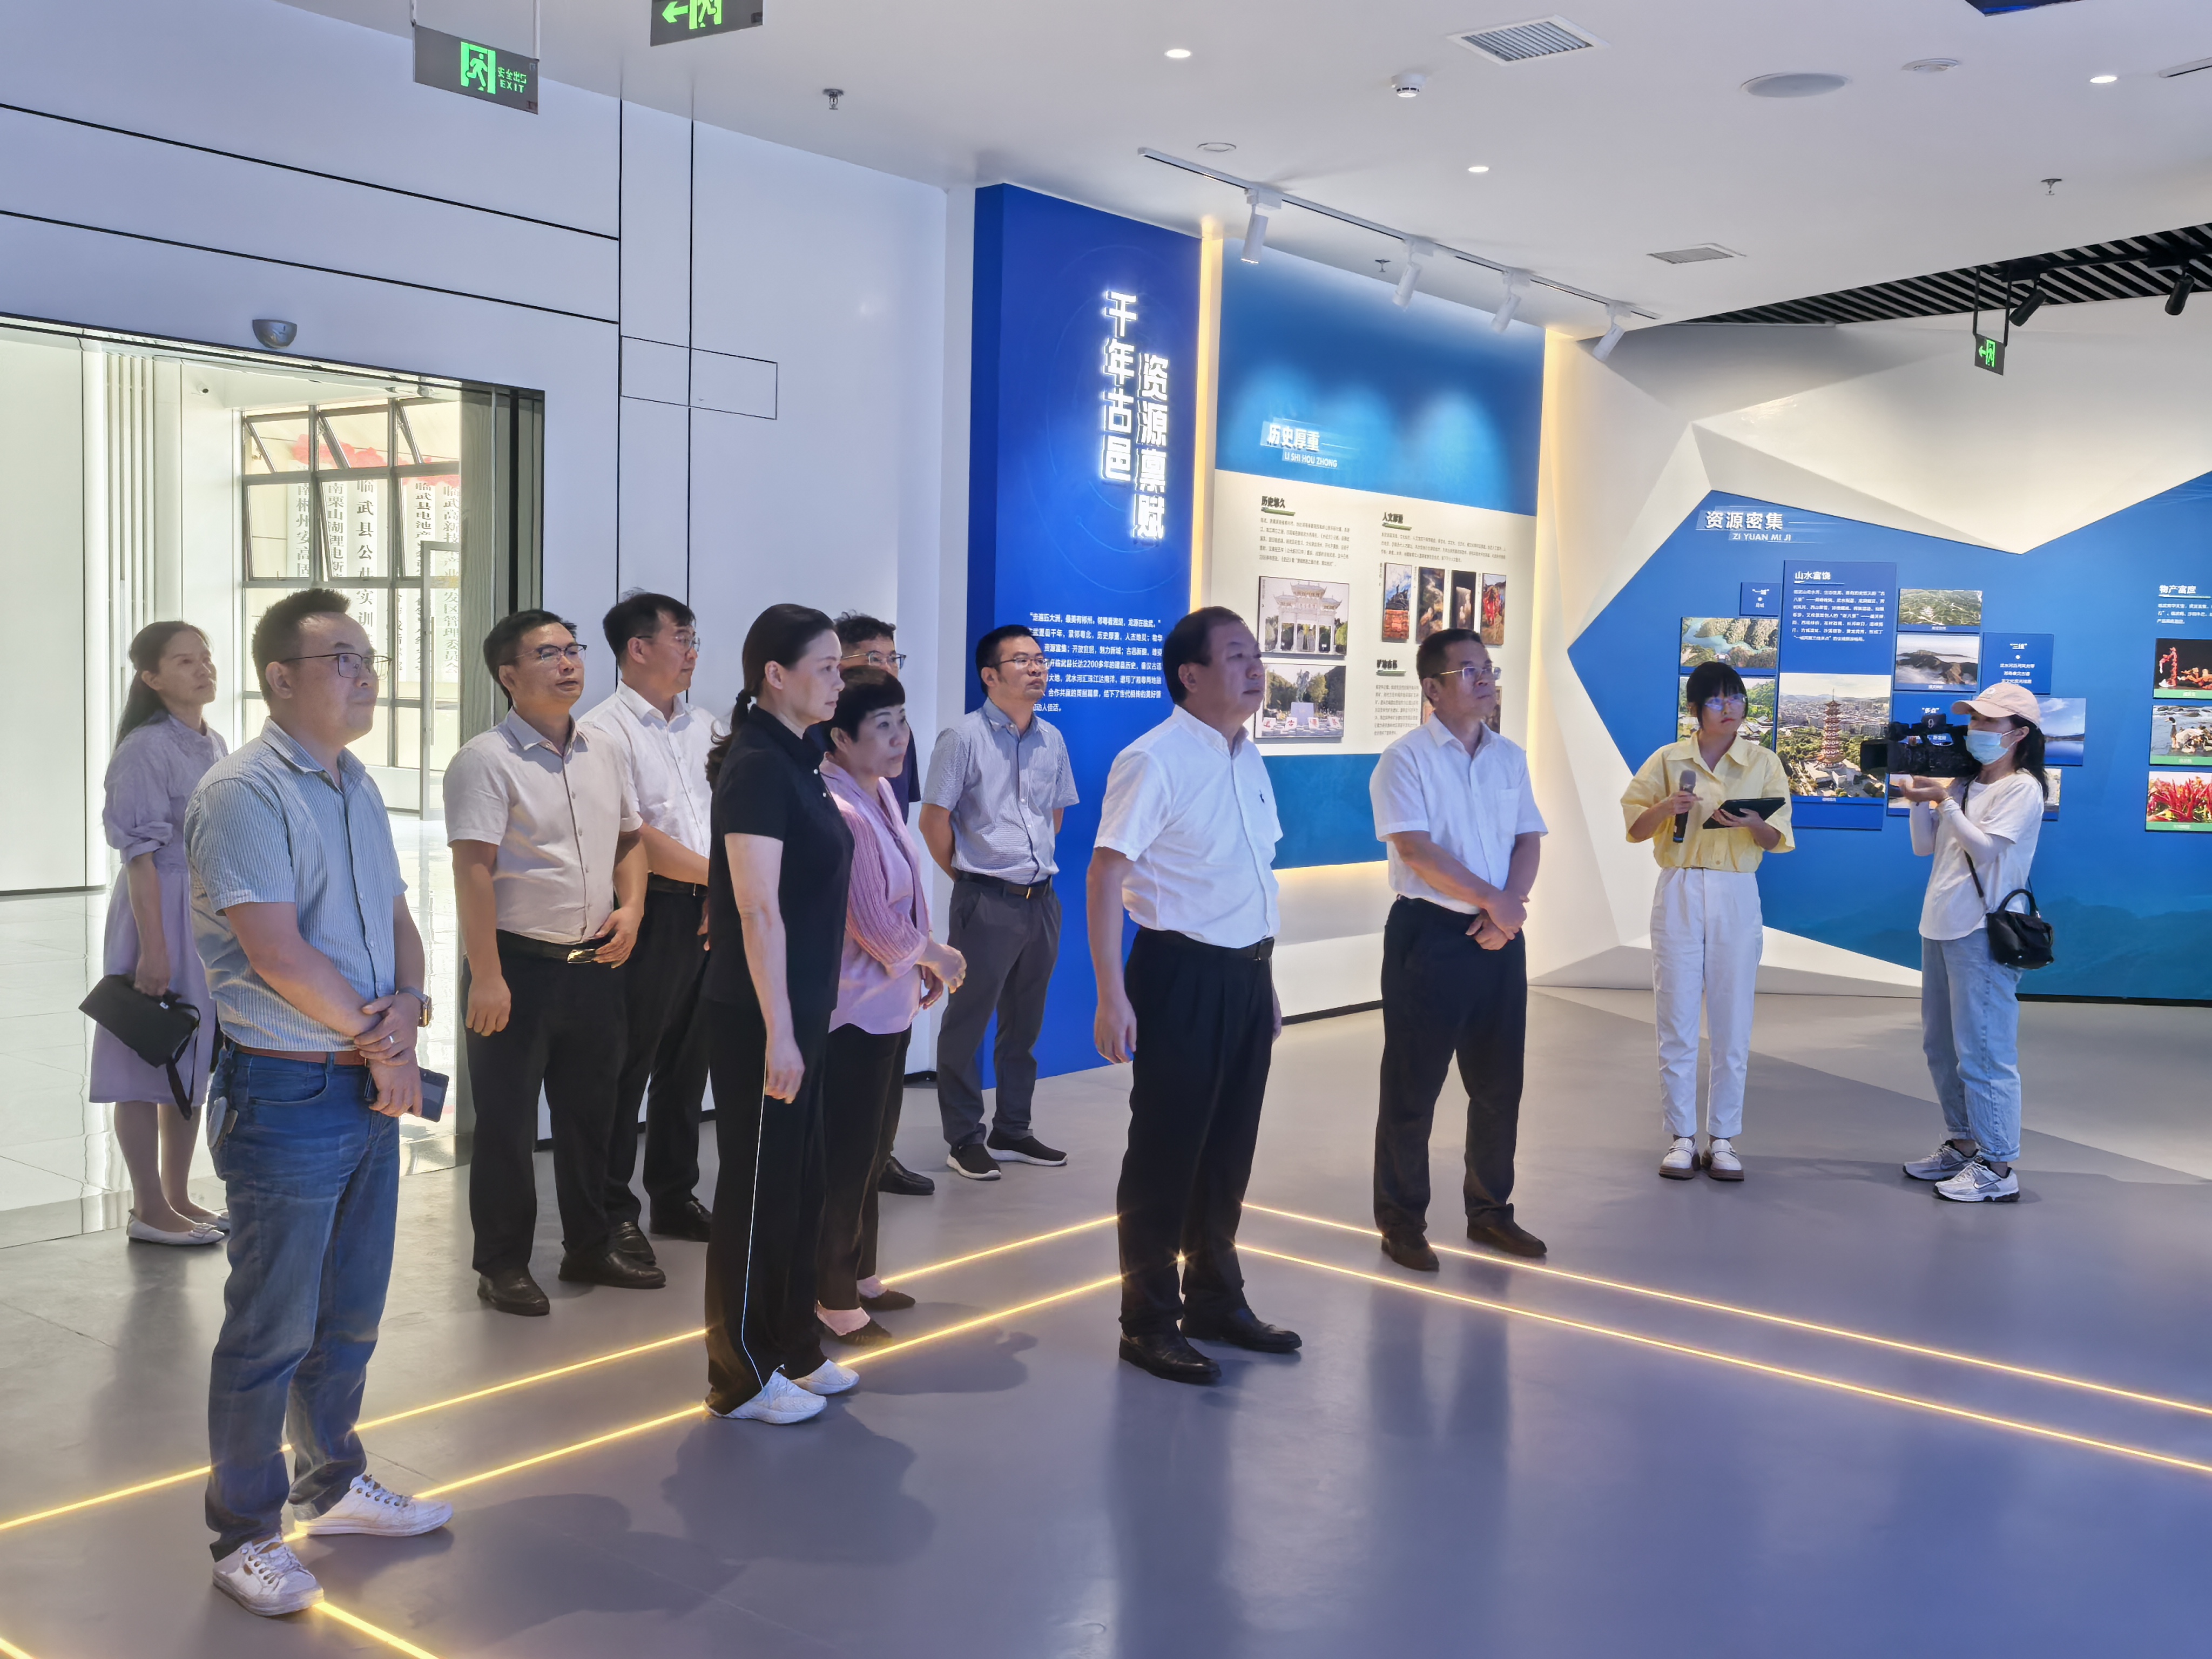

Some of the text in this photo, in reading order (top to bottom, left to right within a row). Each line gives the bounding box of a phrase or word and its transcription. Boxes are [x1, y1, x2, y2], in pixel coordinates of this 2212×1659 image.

[497, 66, 527, 84] 安全出口
[500, 79, 524, 93] EXIT
[1101, 289, 1138, 481] 千年古邑
[1132, 352, 1169, 539] 资源禀赋
[1267, 423, 1320, 451] 历史厚重
[1284, 451, 1338, 468] LI SHI HOU ZHONG
[1705, 510, 1784, 530] 资源密集
[1794, 571, 1831, 581] 山水富饶
[2159, 584, 2196, 595] 物产富庶
